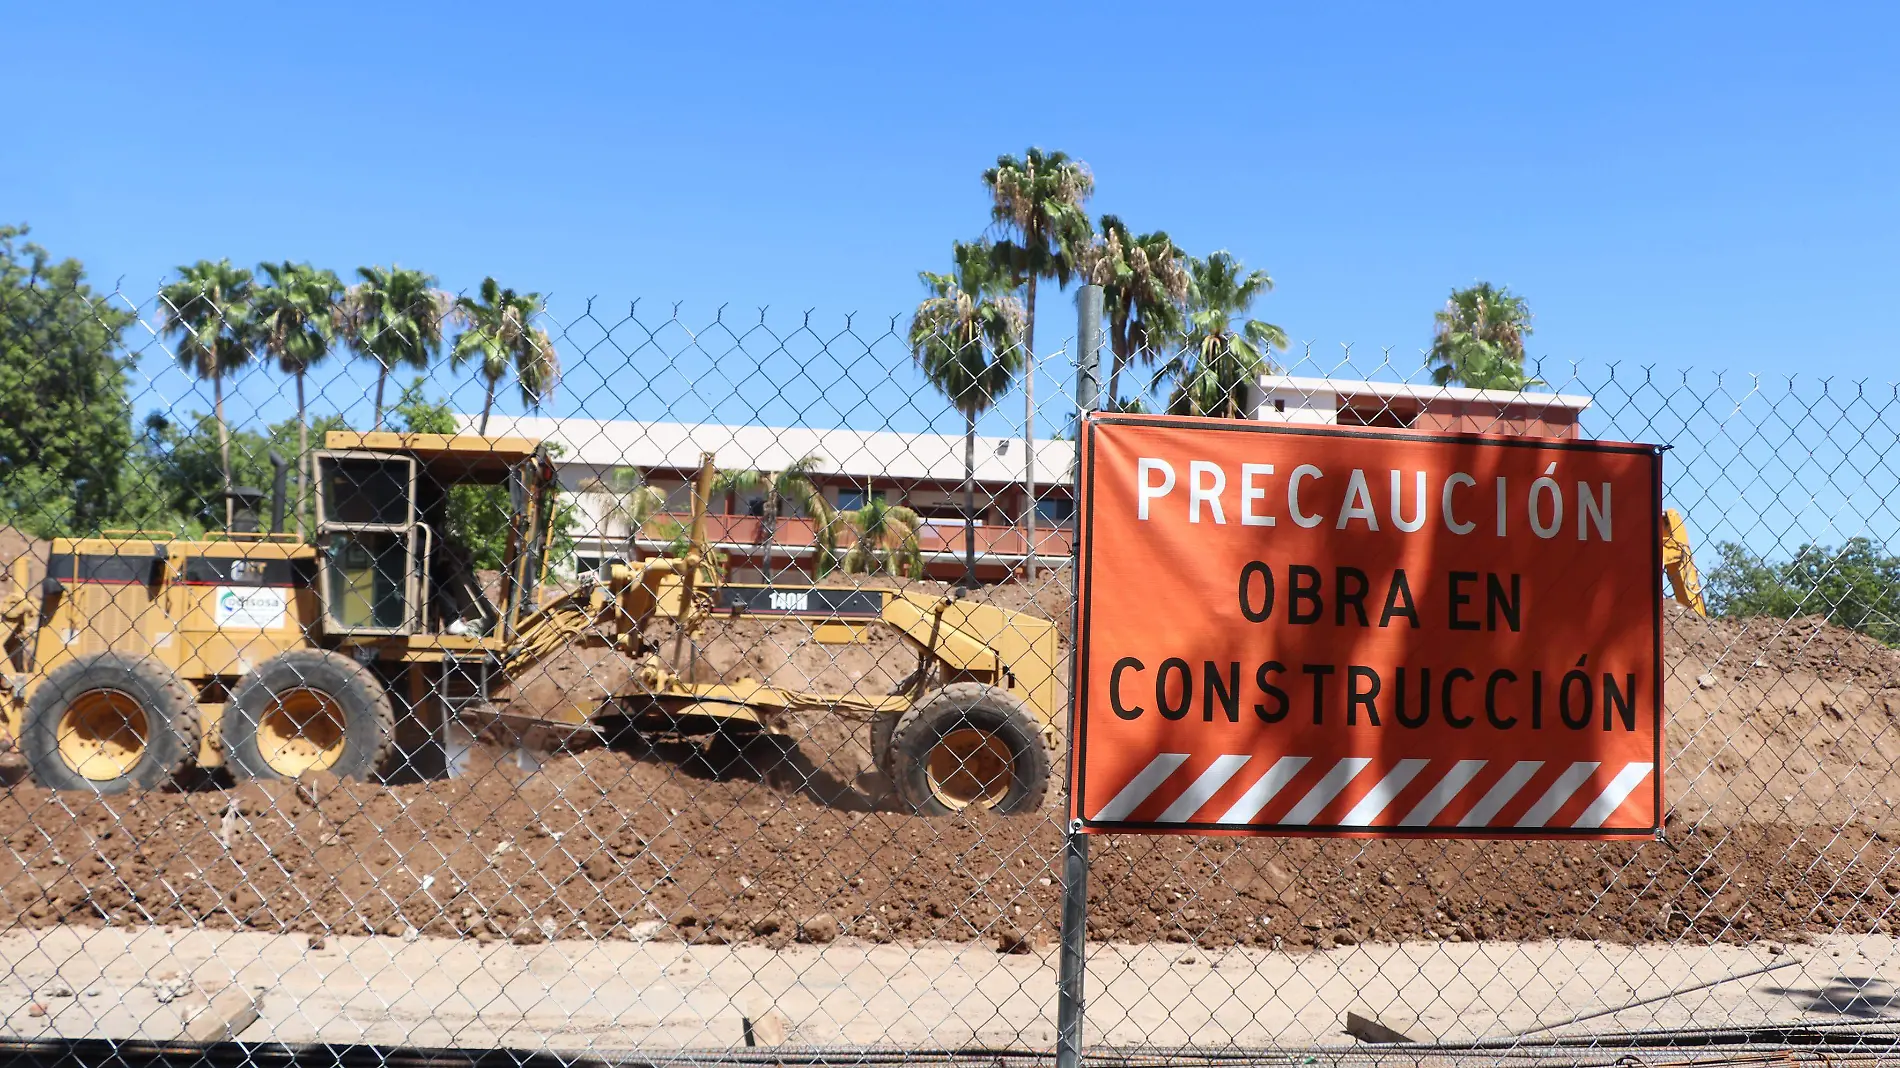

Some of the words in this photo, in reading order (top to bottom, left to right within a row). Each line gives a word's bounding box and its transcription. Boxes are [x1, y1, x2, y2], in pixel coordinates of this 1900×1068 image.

[1137, 458, 1613, 541] PRECAUCIÓN
[769, 592, 808, 610] 140H
[1238, 560, 1419, 629] OBRA
[1449, 571, 1521, 632] EN
[1109, 654, 1636, 732] CONSTRUCCIÓN
